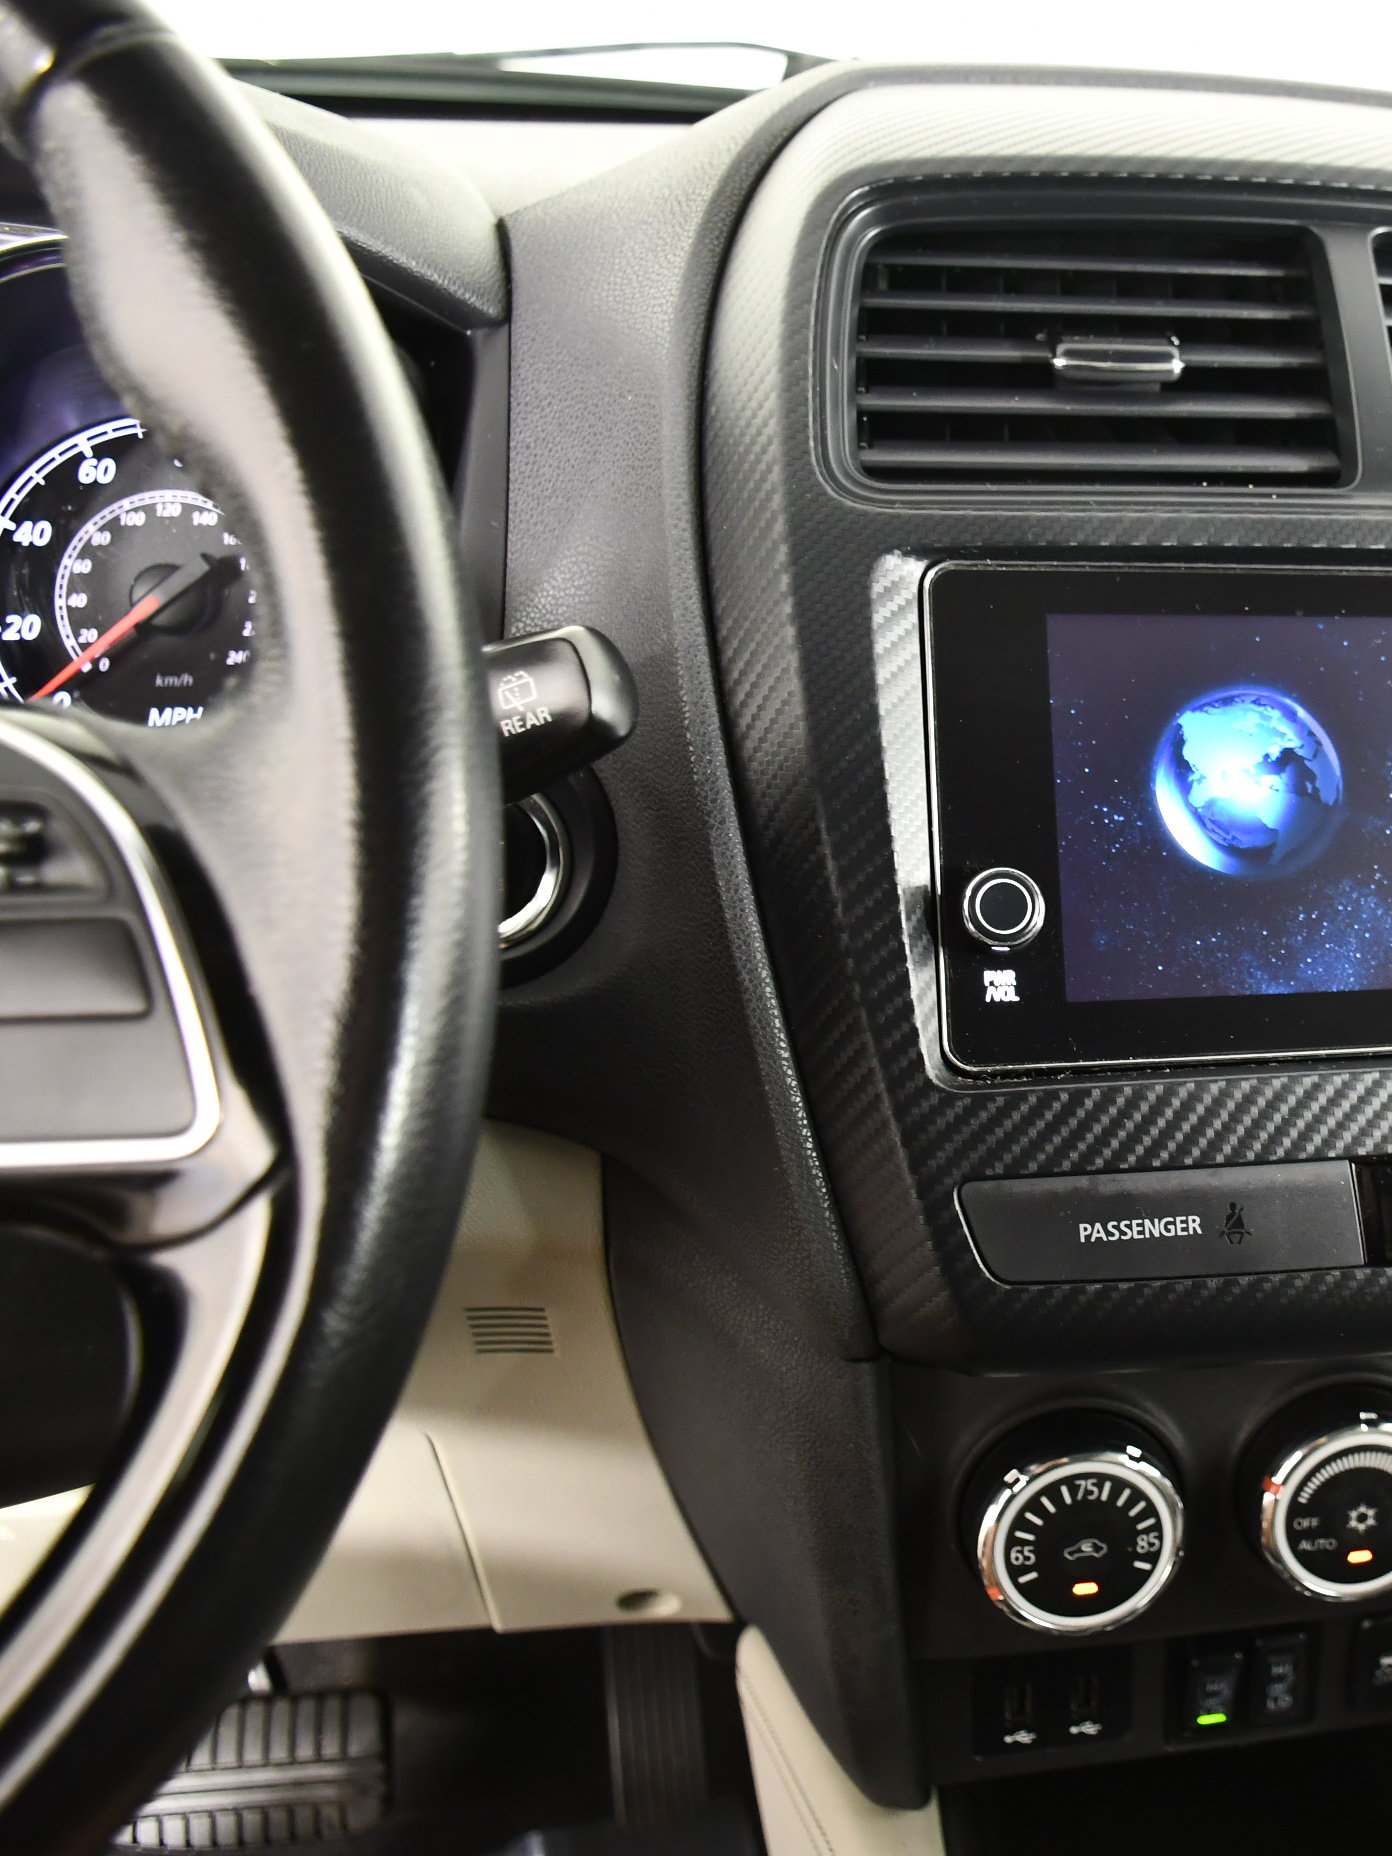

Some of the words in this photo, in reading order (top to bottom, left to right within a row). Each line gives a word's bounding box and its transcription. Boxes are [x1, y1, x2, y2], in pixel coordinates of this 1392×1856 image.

[78, 457, 117, 485] 60
[155, 502, 183, 518] 120
[192, 510, 219, 527] 140
[119, 511, 146, 527] 100
[12, 520, 53, 548] 40
[222, 532, 242, 546] 16
[67, 592, 88, 608] 40
[1, 613, 41, 641] 20
[78, 628, 98, 644] 20
[98, 657, 110, 672] 0
[155, 672, 193, 688] km/h
[147, 706, 204, 728] MPH
[500, 706, 553, 737] REAR
[1078, 1215, 1203, 1243] PASSENGER
[1074, 1478, 1100, 1501] 75
[1293, 1516, 1321, 1530] OFF
[1136, 1532, 1161, 1554] 85
[1298, 1537, 1339, 1551] AUTO
[1010, 1545, 1037, 1566] 65
